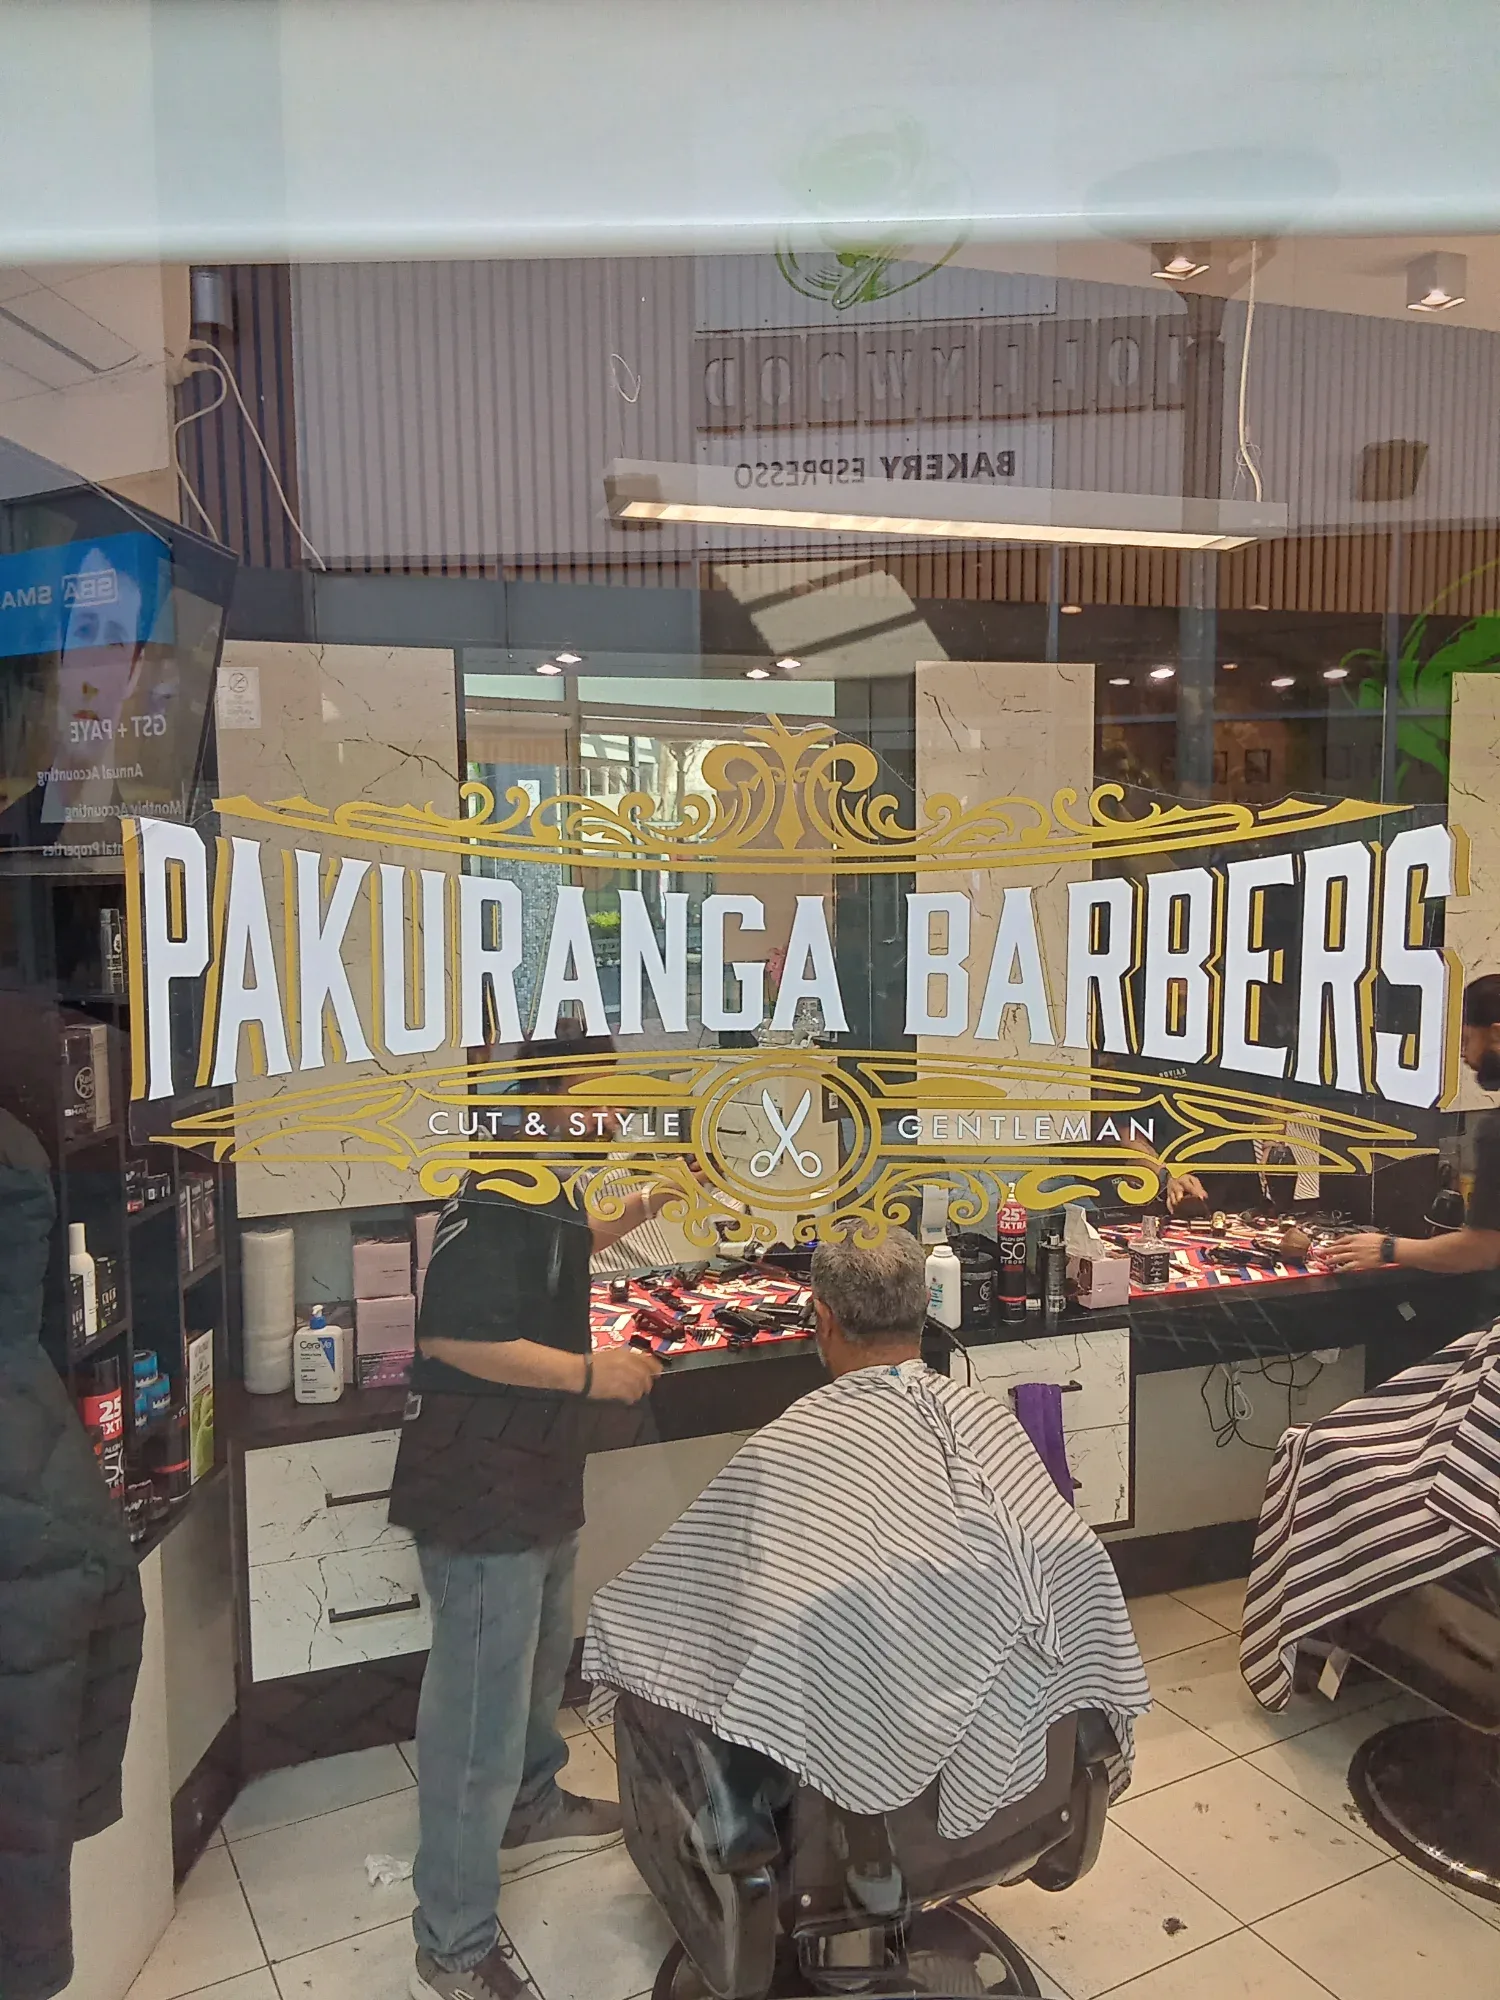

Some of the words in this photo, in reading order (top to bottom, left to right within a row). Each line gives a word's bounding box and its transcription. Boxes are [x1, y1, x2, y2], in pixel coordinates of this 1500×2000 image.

[137, 816, 850, 1101] PAKURANGA
[903, 824, 1455, 1110] BARBERS
[427, 1111, 510, 1137] CUT
[524, 1111, 556, 1138] &
[570, 1111, 681, 1138] STYLE
[897, 1113, 1156, 1142] GENTLEMAN
[999, 1220, 1027, 1231] EXTRA
[999, 1241, 1026, 1260] SO
[299, 1339, 332, 1351] CeraVe
